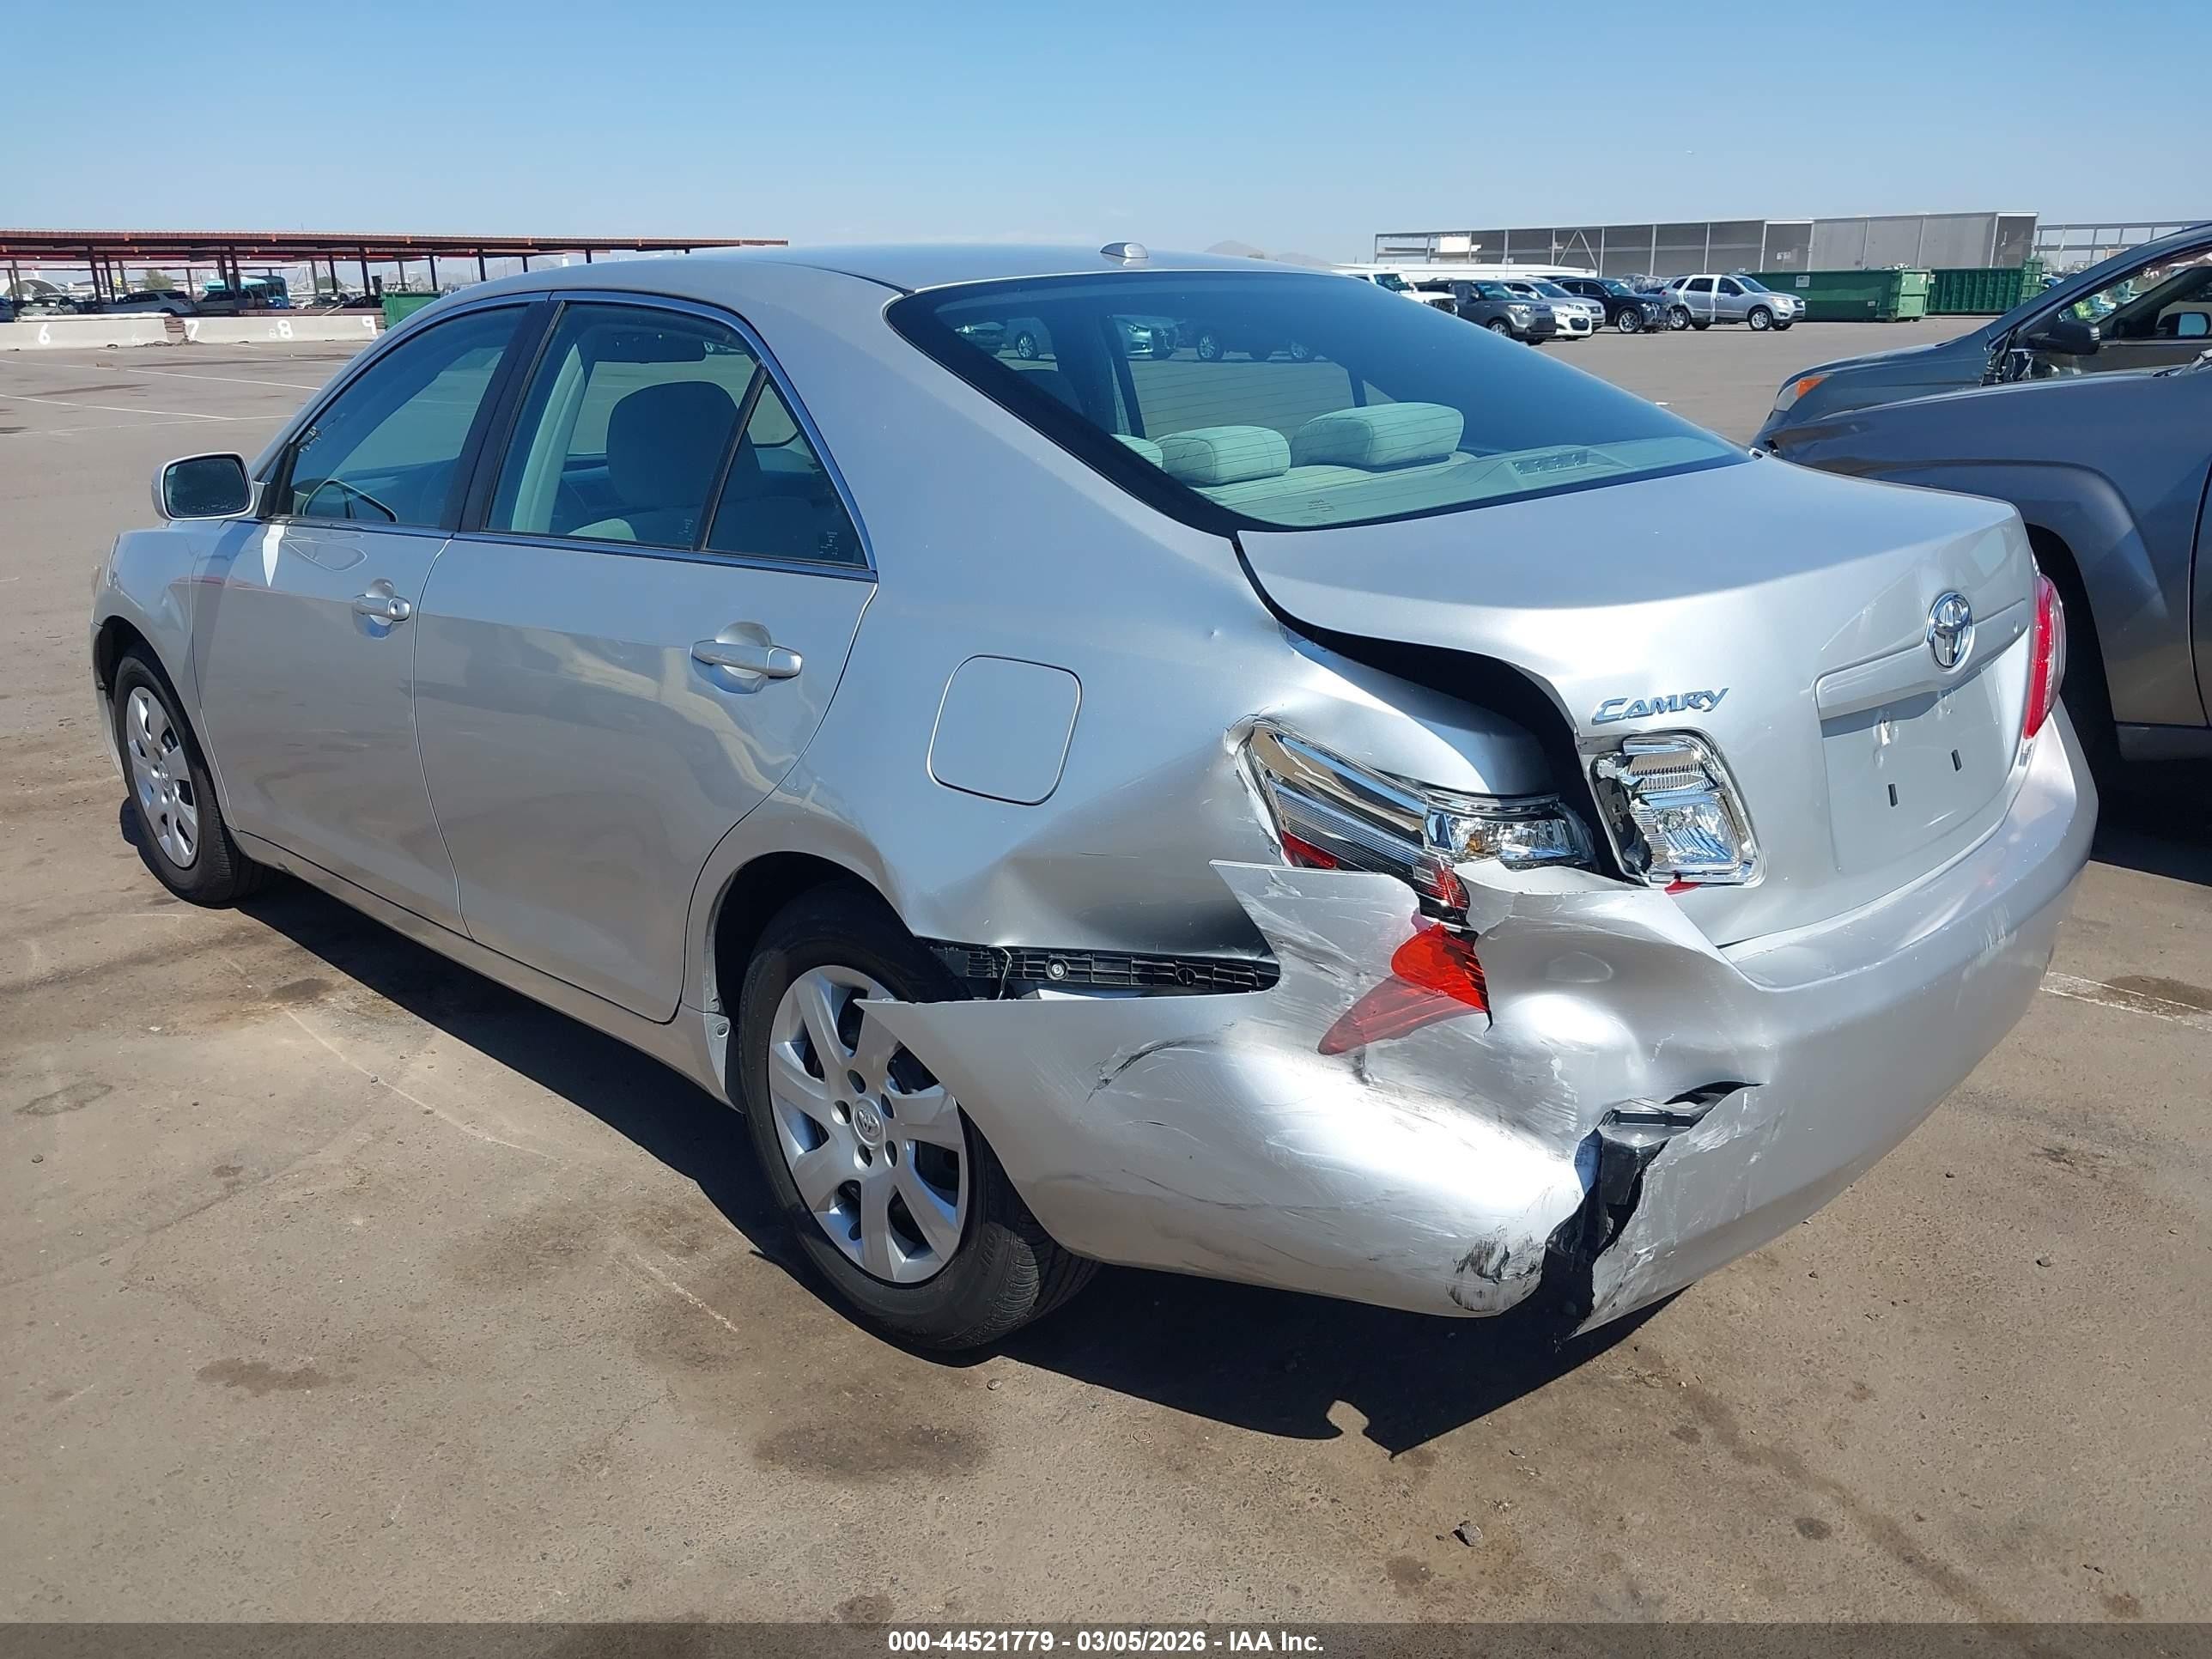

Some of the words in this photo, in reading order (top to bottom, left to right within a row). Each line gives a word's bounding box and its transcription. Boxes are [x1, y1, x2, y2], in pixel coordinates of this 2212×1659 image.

[38, 322, 51, 345] 6
[184, 319, 200, 340] 7
[277, 319, 294, 339] 8
[362, 315, 378, 336] 9
[1591, 687, 1729, 726] CAMRY
